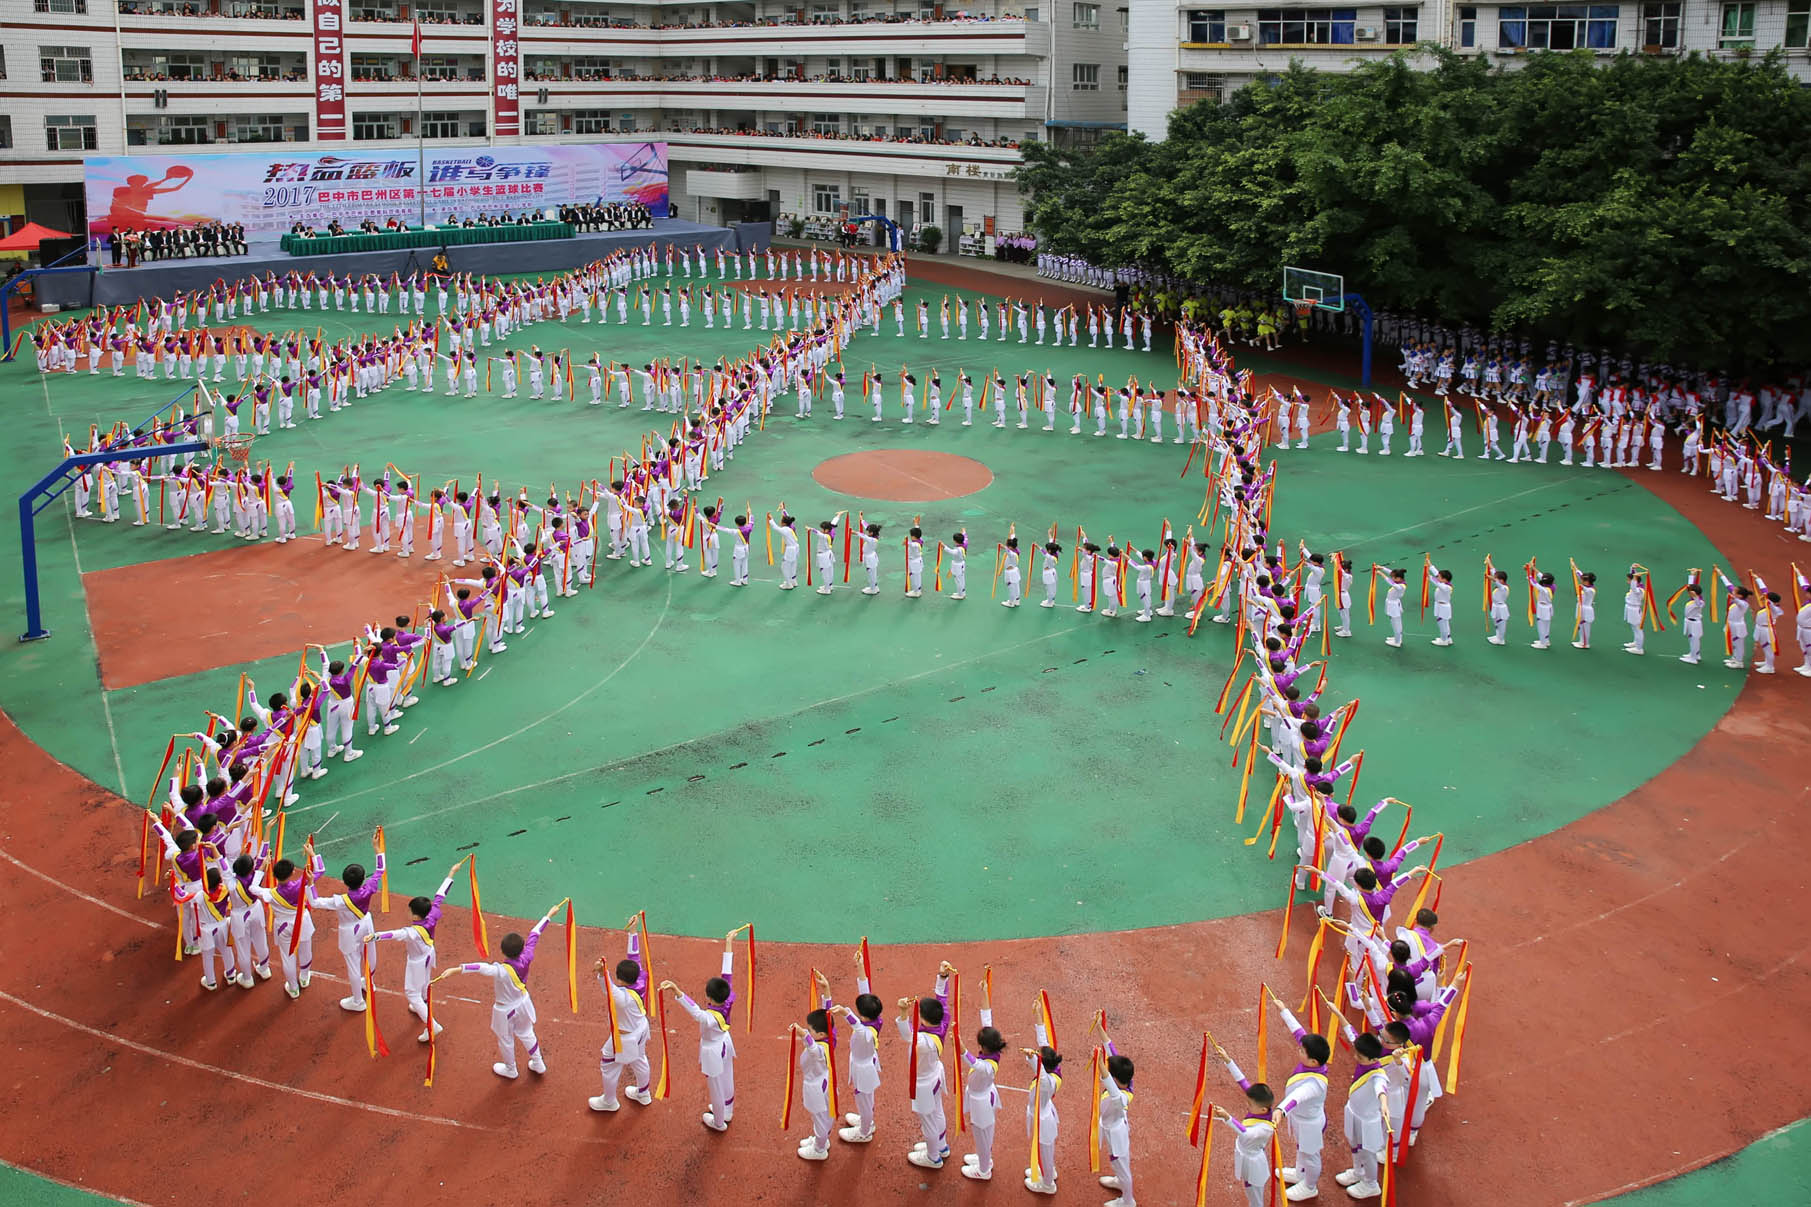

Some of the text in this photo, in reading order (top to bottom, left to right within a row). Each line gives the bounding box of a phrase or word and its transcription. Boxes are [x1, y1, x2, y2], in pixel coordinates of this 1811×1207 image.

[429, 161, 552, 182] 谁与争锋
[264, 186, 316, 208] 2017
